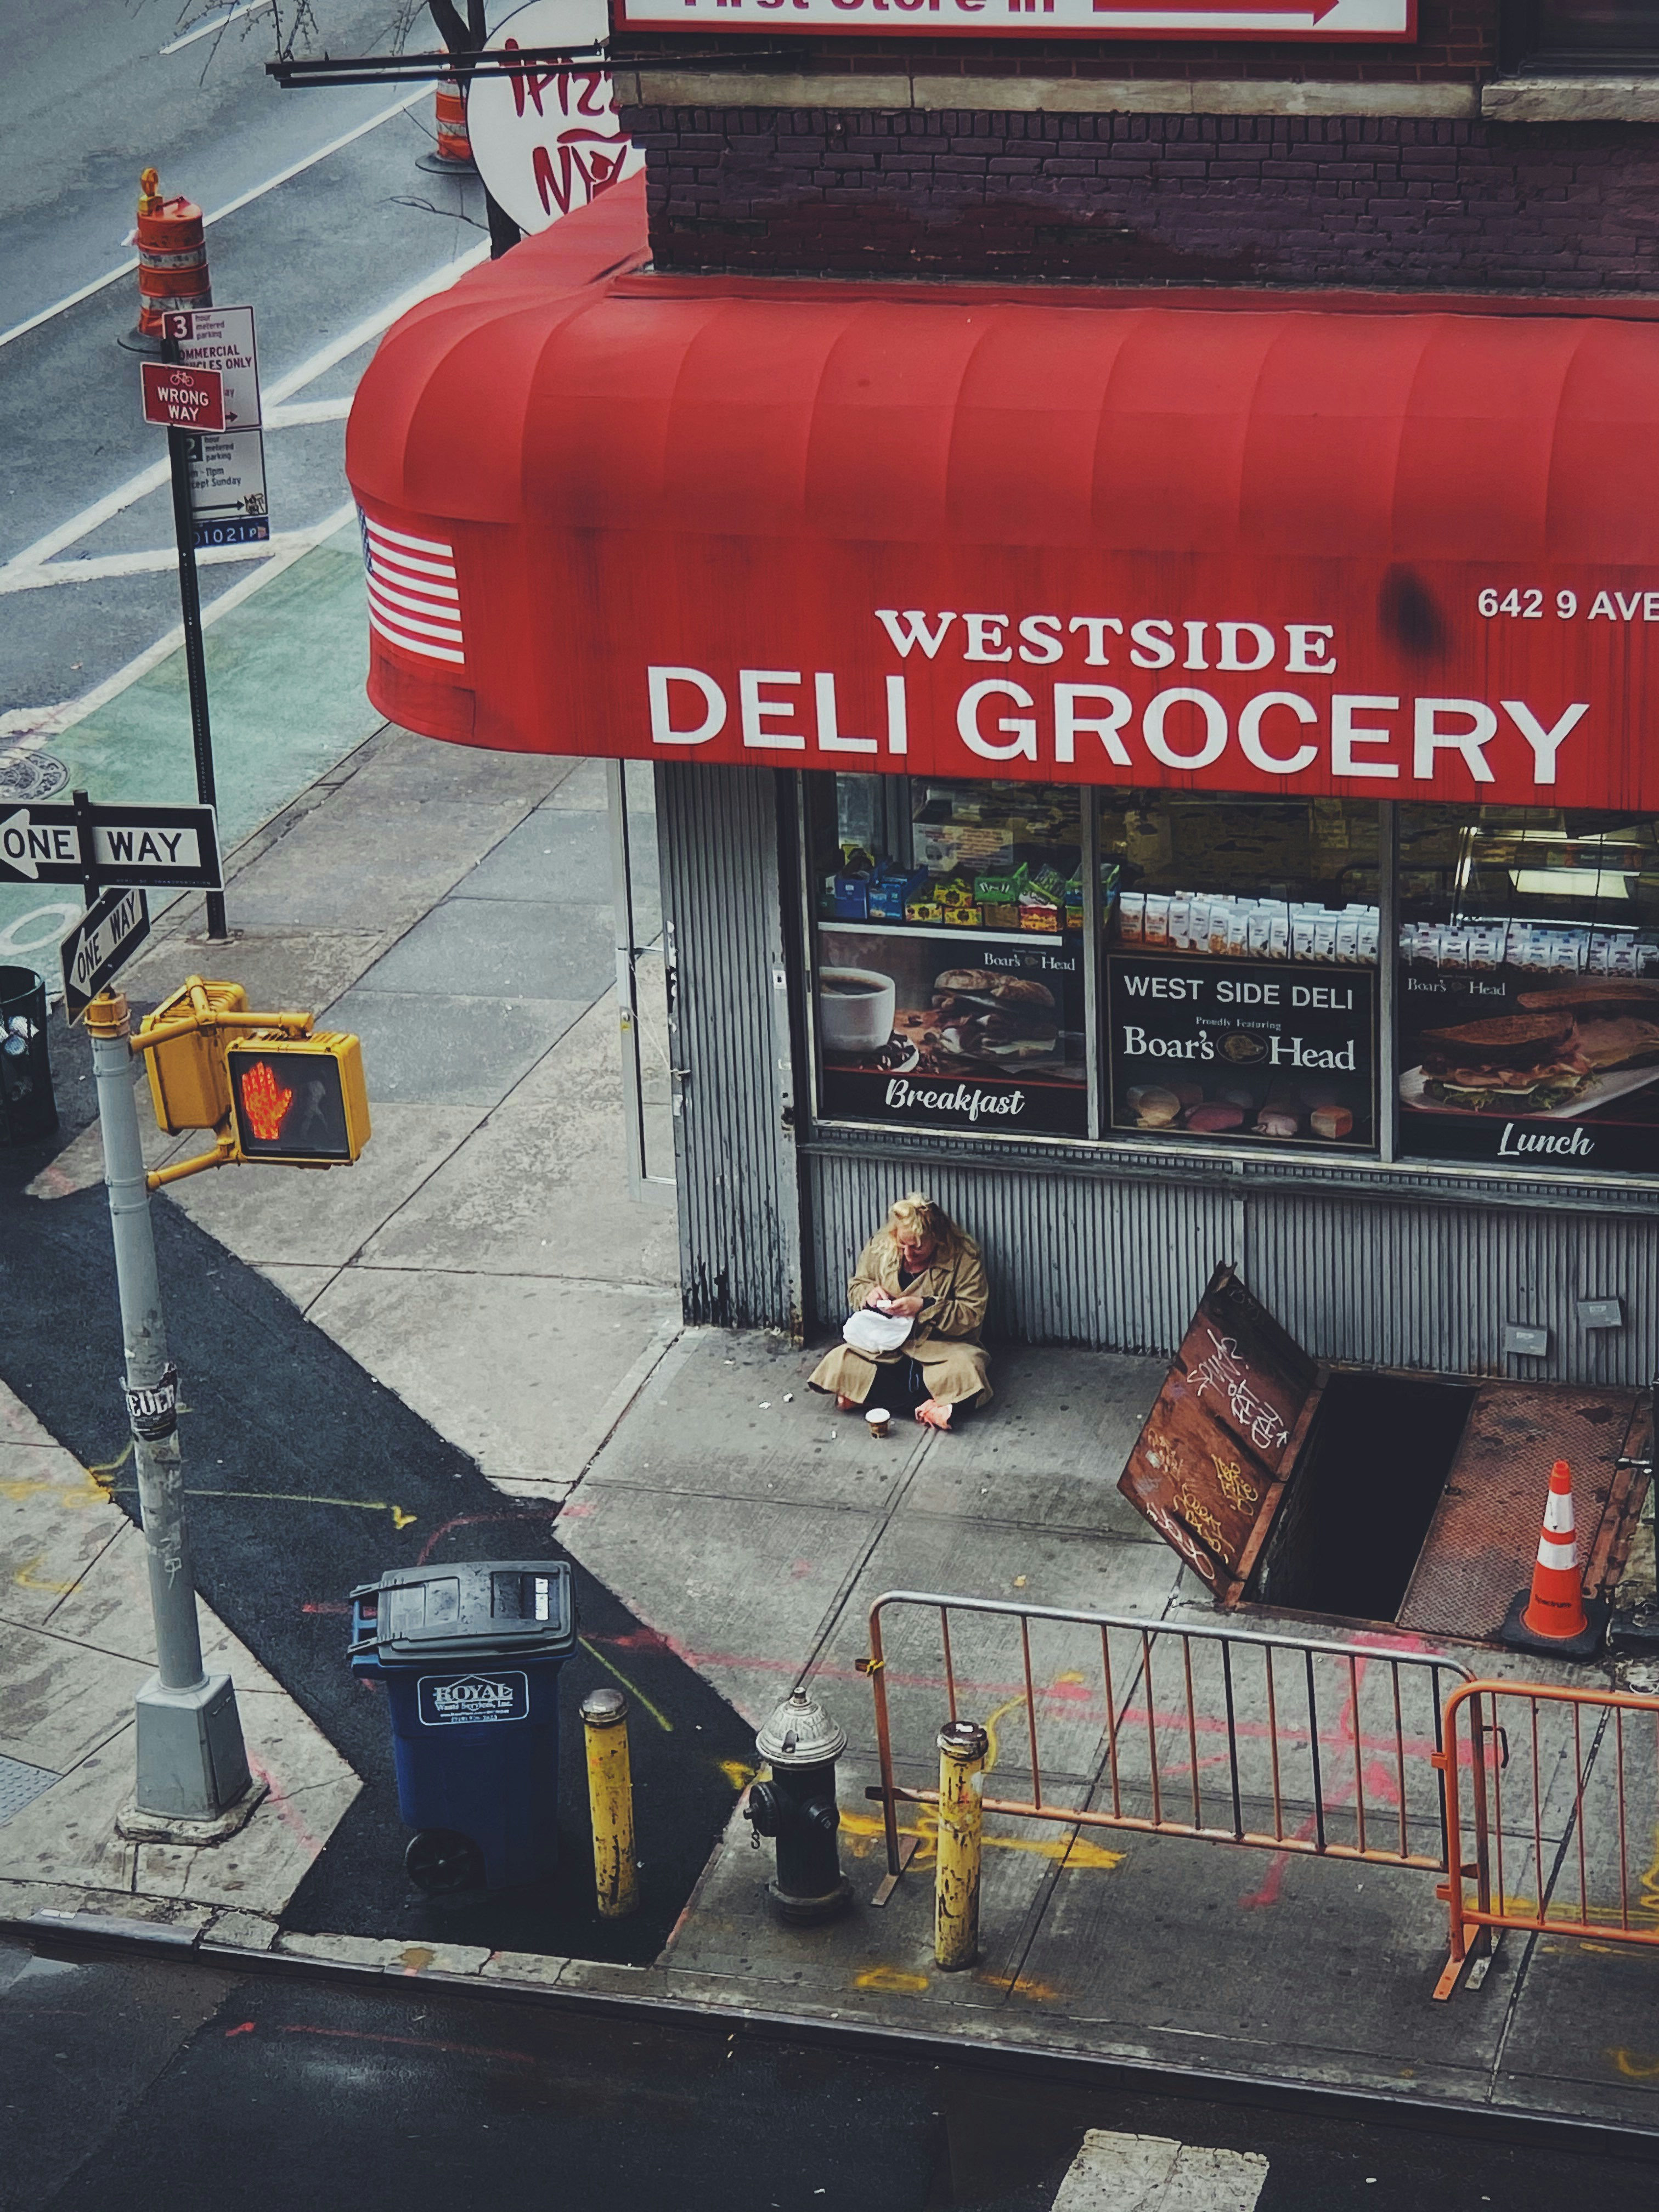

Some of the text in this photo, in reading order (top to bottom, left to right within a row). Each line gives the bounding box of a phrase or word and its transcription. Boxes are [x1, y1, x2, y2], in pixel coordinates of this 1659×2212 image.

[173, 315, 188, 338] 3
[196, 321, 225, 330] metered
[196, 331, 222, 340] parking
[180, 344, 240, 360] OMMERCIAL
[225, 357, 252, 370] ONLY
[157, 386, 209, 407] WRONG
[168, 404, 199, 422] WAY
[212, 477, 242, 487] Sunday
[1478, 588, 1659, 621] 642 9 AVE
[874, 610, 1337, 675] WESTSIDE
[648, 666, 1590, 785] DELI GROCERY
[3, 828, 182, 863] ONE WAY
[77, 891, 136, 984] ONE WAY
[984, 952, 1021, 967] Boar's
[1041, 956, 1075, 971] Head
[1124, 975, 1353, 1010] WEST SIDE DELI
[1407, 978, 1506, 996] Boar's Head
[1195, 1016, 1282, 1031] Proudly Featuring
[1123, 1025, 1356, 1071] Boar's Head
[885, 1078, 1025, 1122] Breakfast
[1497, 1122, 1595, 1156] Lunch
[1535, 1594, 1572, 1608] Spectrum
[433, 1683, 514, 1702] ROYAL
